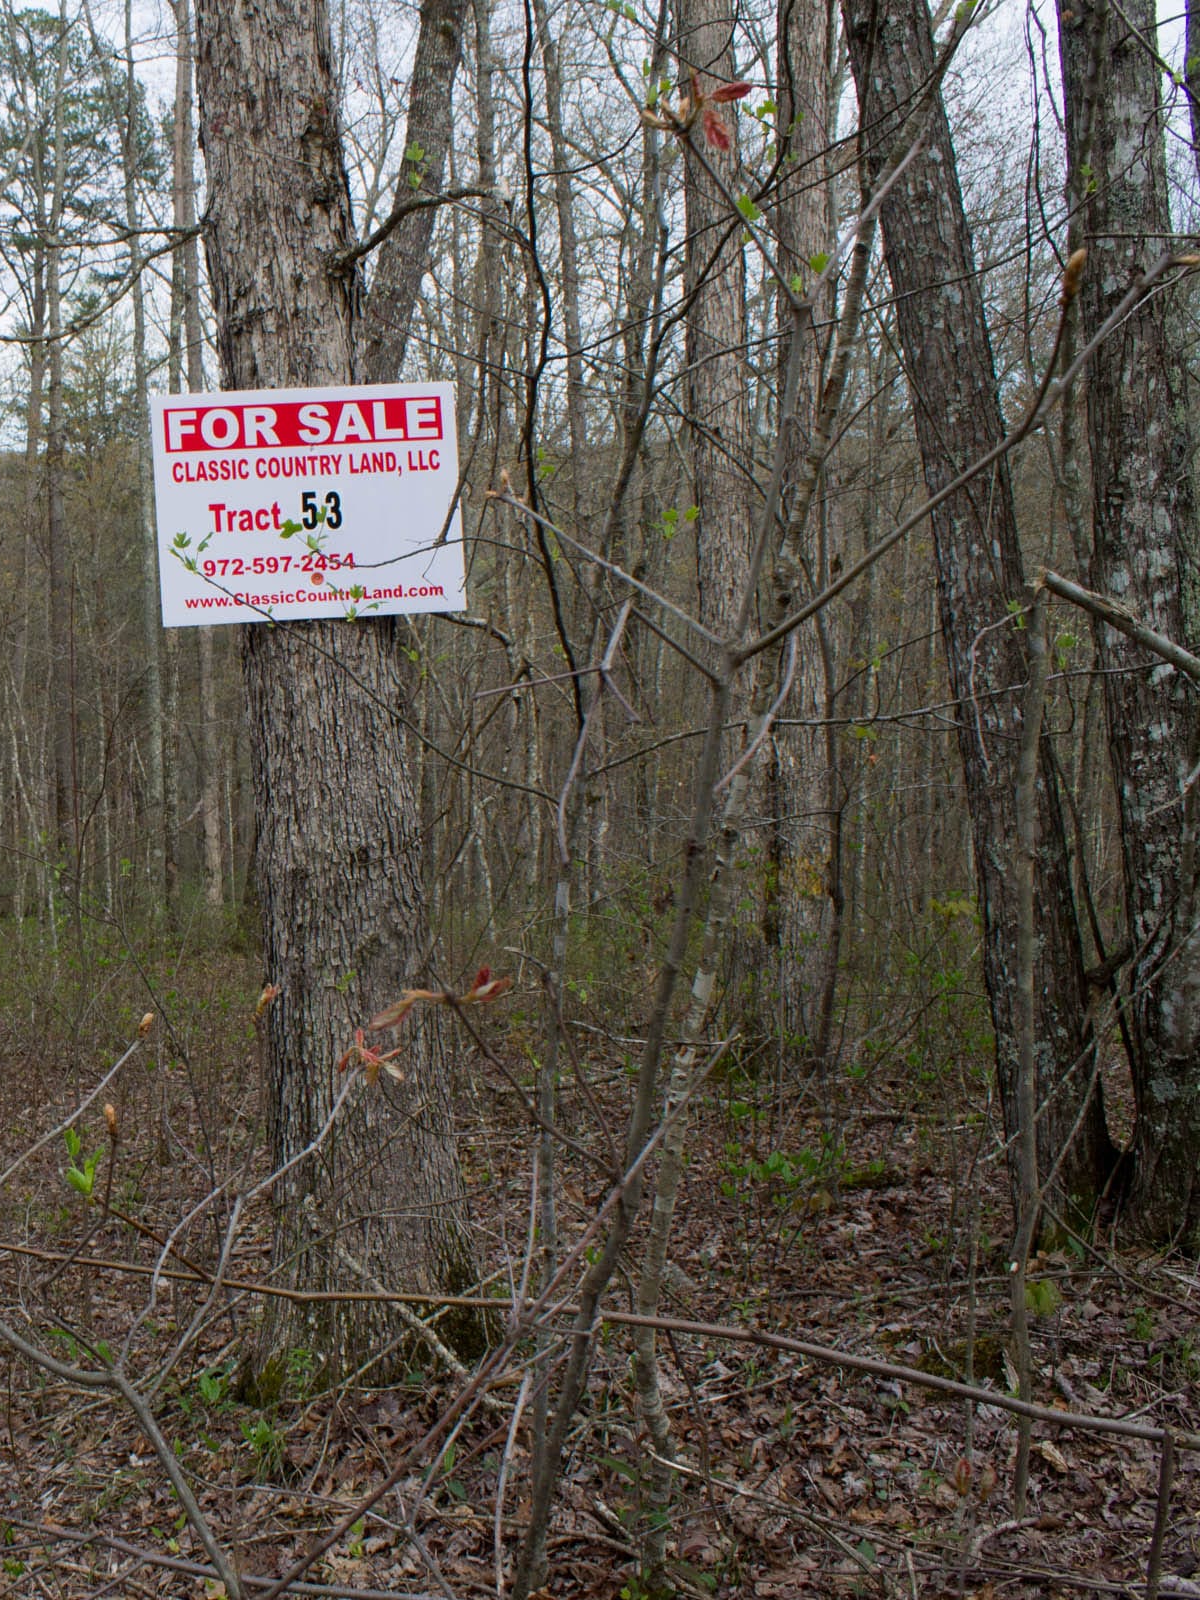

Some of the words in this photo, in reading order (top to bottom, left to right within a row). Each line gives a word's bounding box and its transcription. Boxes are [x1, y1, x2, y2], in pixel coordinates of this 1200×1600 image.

[167, 407, 281, 450] FOR
[297, 399, 439, 444] SALE
[172, 460, 250, 483] CLASSIC
[255, 454, 343, 478] COUNTRY
[349, 452, 402, 476] LAND,
[408, 449, 441, 471] LLC
[208, 502, 281, 533] Tract
[301, 491, 343, 530] 53
[203, 553, 355, 577] 972-597-2454
[185, 584, 444, 609] www.ClassicCountrLand.com
